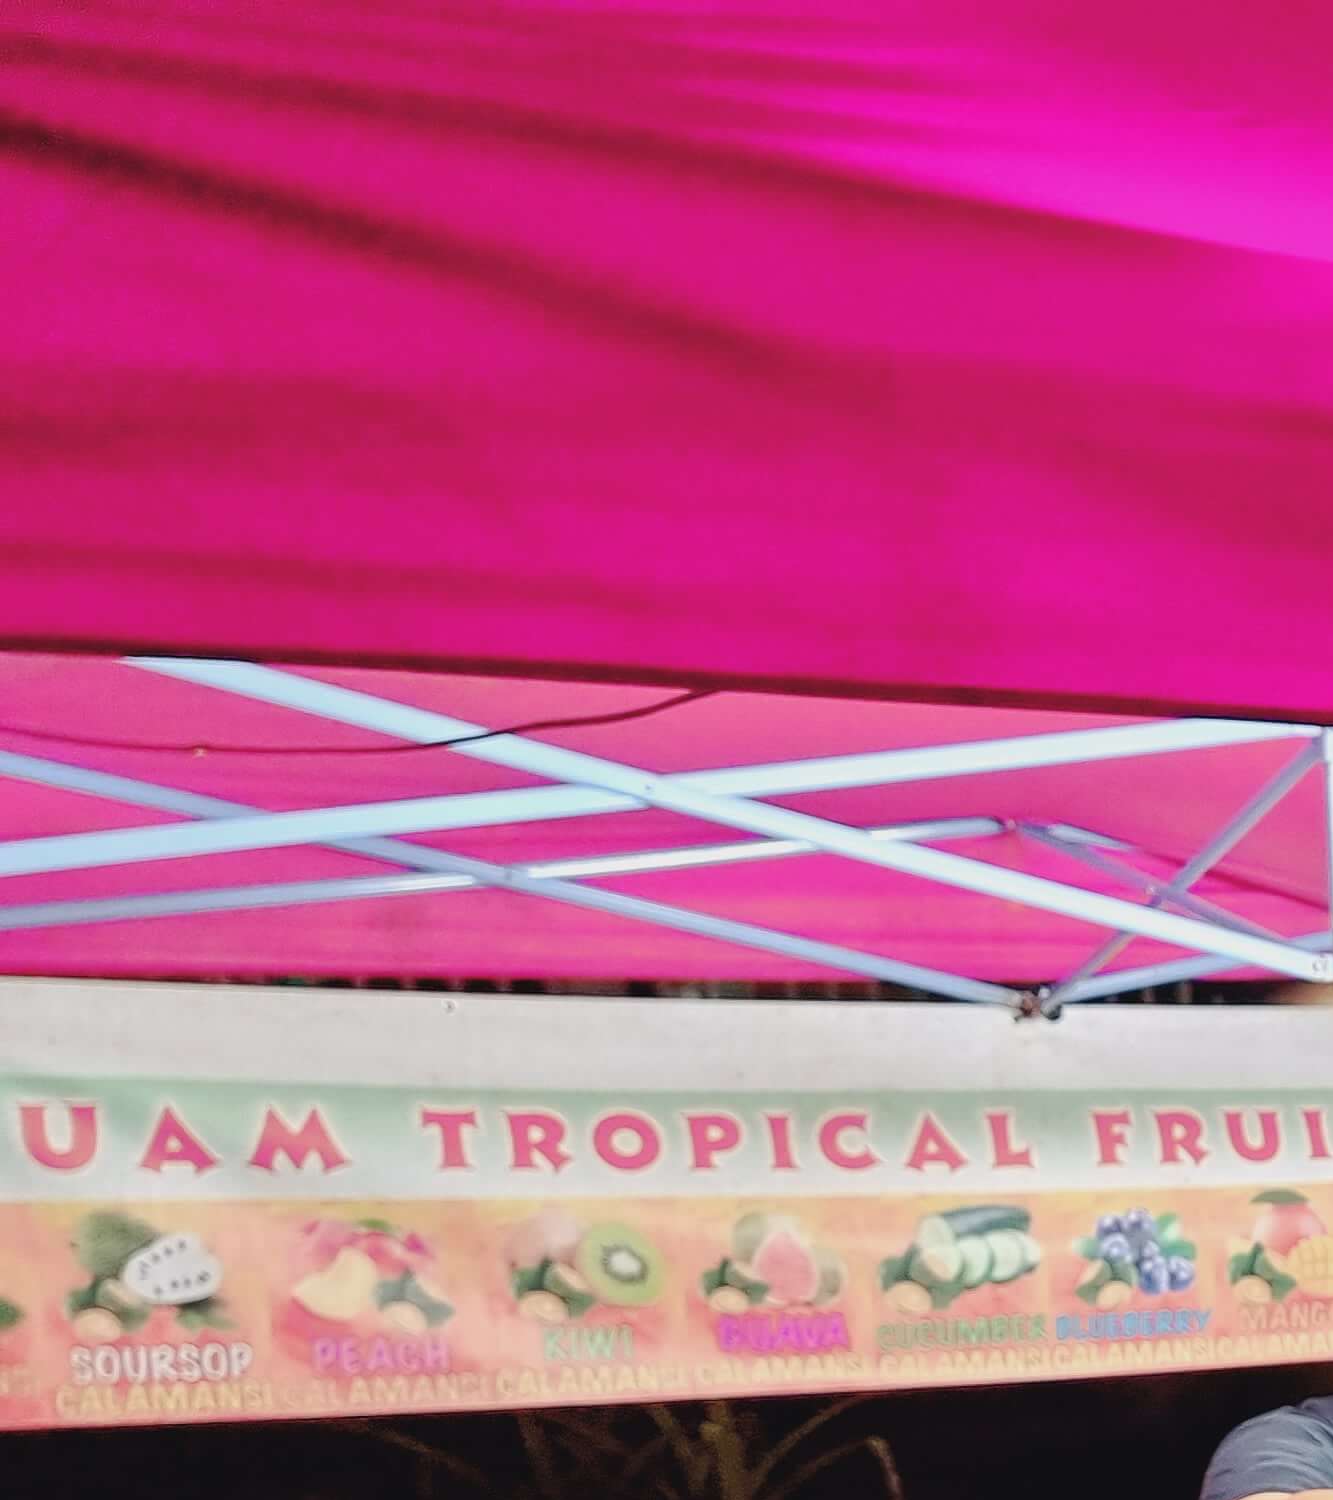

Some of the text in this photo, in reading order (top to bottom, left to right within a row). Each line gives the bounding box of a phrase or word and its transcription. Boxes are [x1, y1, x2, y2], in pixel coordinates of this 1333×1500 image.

[420, 1106, 1037, 1174] TROPICAL
[541, 1325, 637, 1361] KIWI
[716, 1311, 850, 1356] GUAVA
[877, 1313, 1048, 1351] CUCUMBER
[1055, 1308, 1212, 1341] BLUEBERRY
[68, 1341, 256, 1385] SOURSOP
[312, 1335, 450, 1374] PEACH
